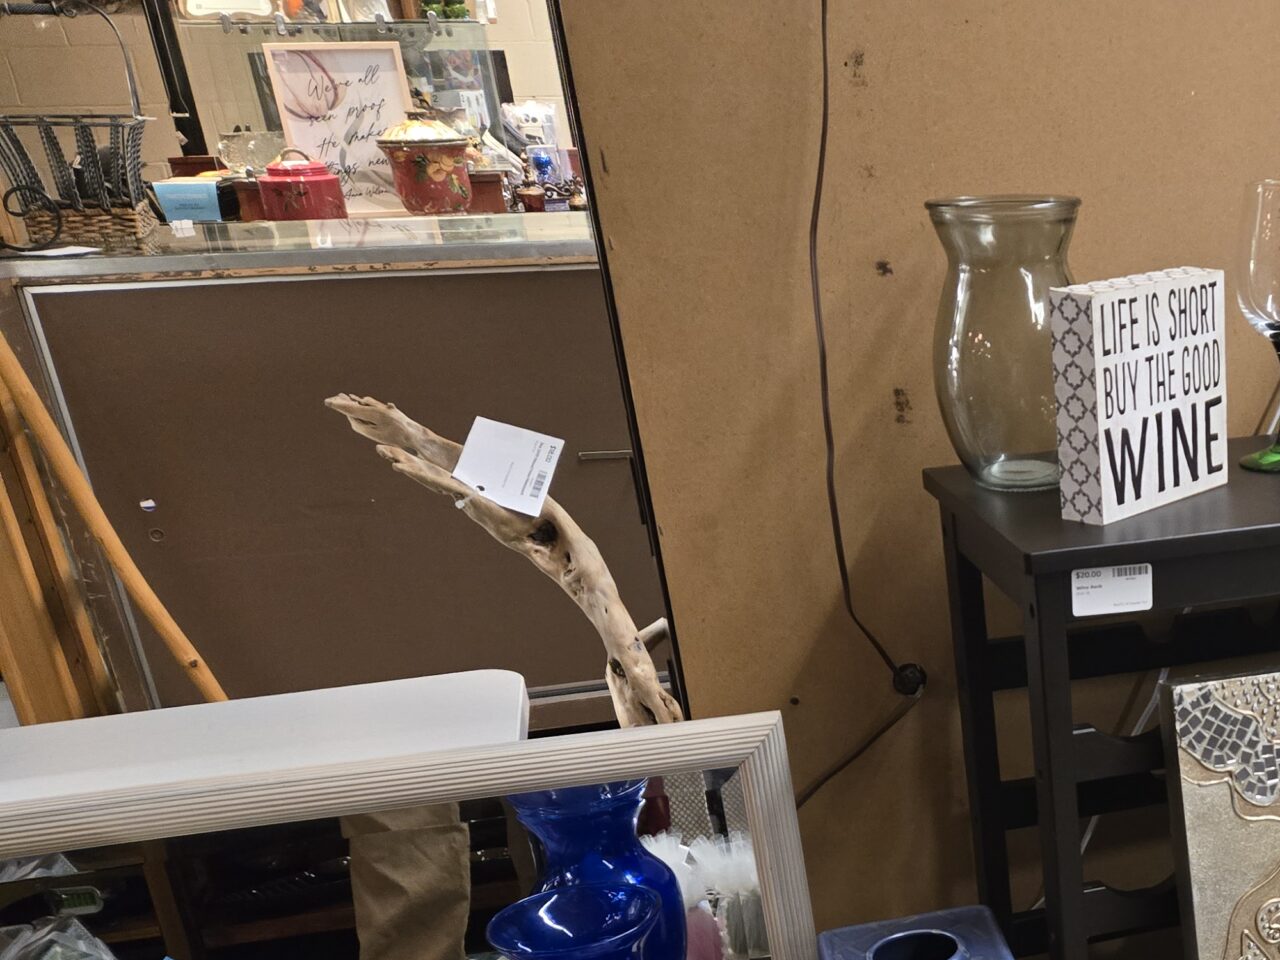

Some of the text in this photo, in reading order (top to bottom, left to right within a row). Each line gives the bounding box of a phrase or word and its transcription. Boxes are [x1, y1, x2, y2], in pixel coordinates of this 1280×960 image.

[358, 64, 380, 86] all
[345, 98, 387, 123] proof
[316, 132, 341, 158] He
[1100, 281, 1217, 356] LIFE IS SHORT
[1103, 339, 1220, 419] BUY THE GOOD
[1104, 396, 1223, 506] WINE
[1075, 570, 1102, 579] $20.00
